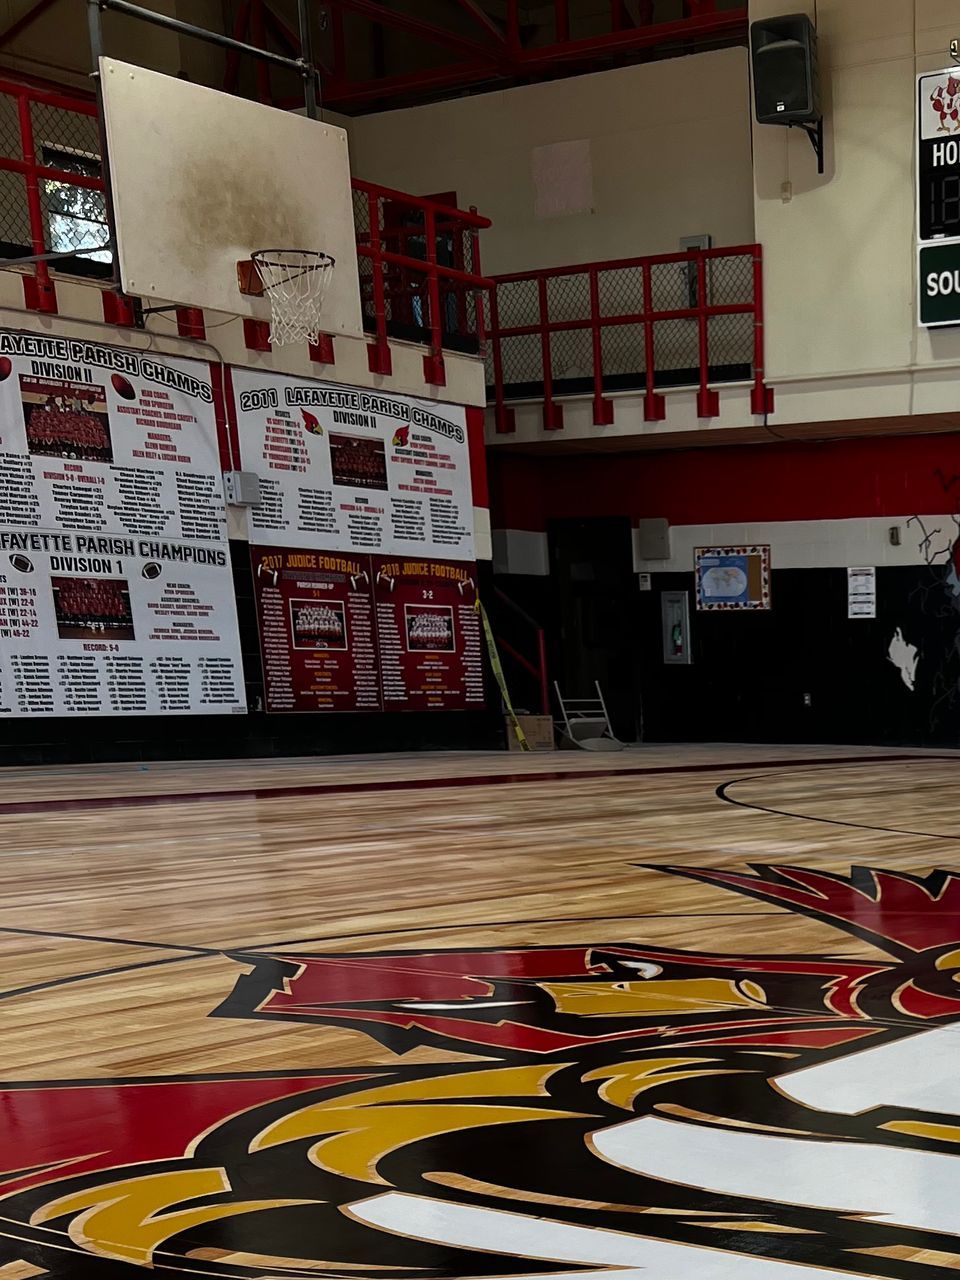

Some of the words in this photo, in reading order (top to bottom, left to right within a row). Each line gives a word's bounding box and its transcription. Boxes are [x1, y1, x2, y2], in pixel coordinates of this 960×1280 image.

[31, 360, 82, 382] DIVISION
[84, 368, 93, 383] II
[70, 340, 139, 376] PARISH
[141, 359, 214, 403] CHAMPS
[240, 388, 279, 411] 2011
[285, 387, 360, 410] LAFAYETTE
[361, 393, 410, 422] PARISH
[411, 407, 465, 443] CHAMPS
[333, 410, 369, 428] DIVISION
[370, 415, 377, 429] II
[76, 536, 135, 556] PARISH
[139, 542, 227, 567] CHAMPIONS
[50, 555, 112, 574] DIVISION
[116, 560, 124, 574] 1
[262, 555, 283, 570] 2017
[286, 554, 317, 568] JUDICE
[318, 556, 360, 575] FOOTBALL
[402, 562, 429, 576] JUDICE
[430, 564, 469, 581] FOOTBALL
[422, 589, 434, 599] 3-2
